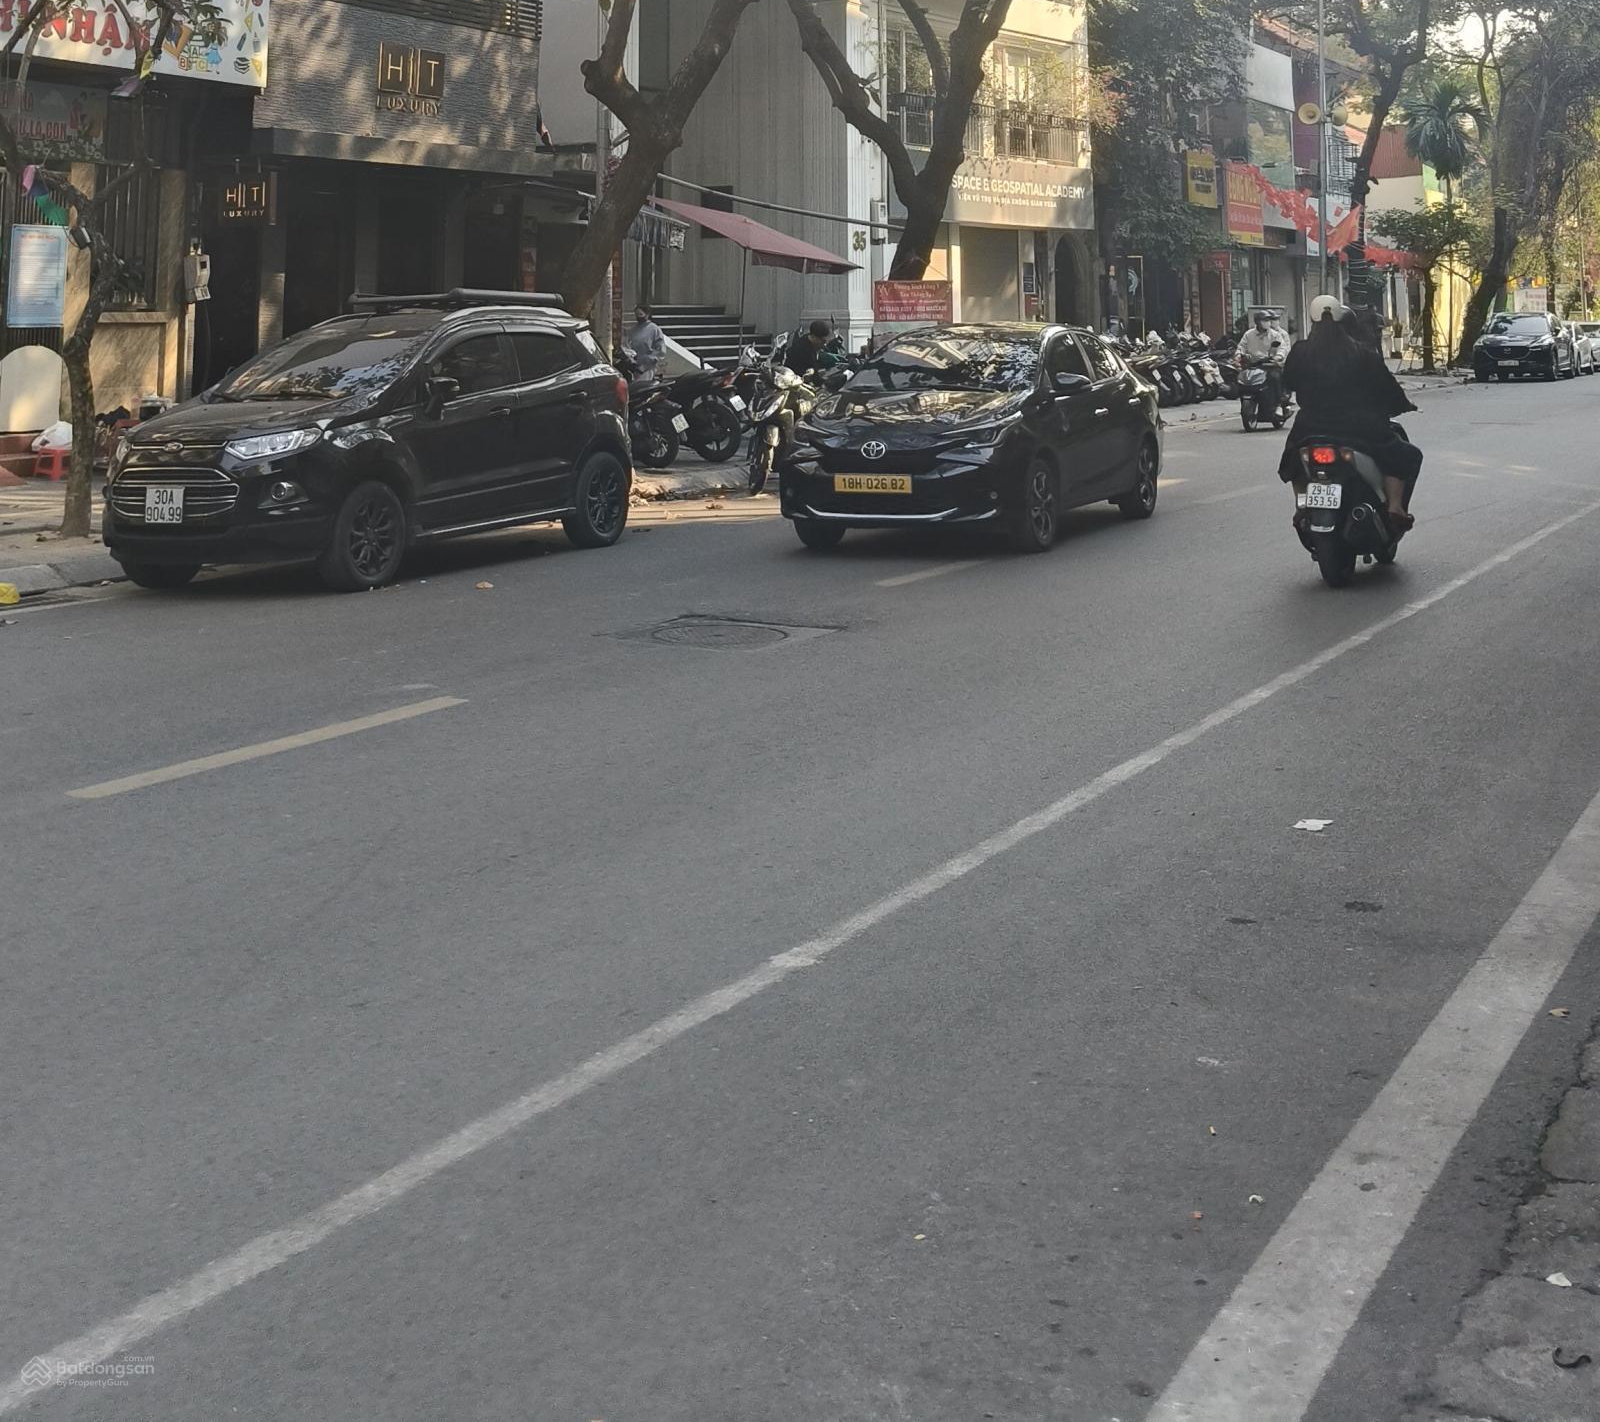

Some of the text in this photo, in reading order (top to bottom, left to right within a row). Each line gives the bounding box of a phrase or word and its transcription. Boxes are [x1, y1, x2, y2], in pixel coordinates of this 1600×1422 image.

[951, 174, 1086, 198] SPACE & GEOSPATIAL ACADEMY
[853, 231, 867, 252] 35
[155, 489, 174, 505] 30A
